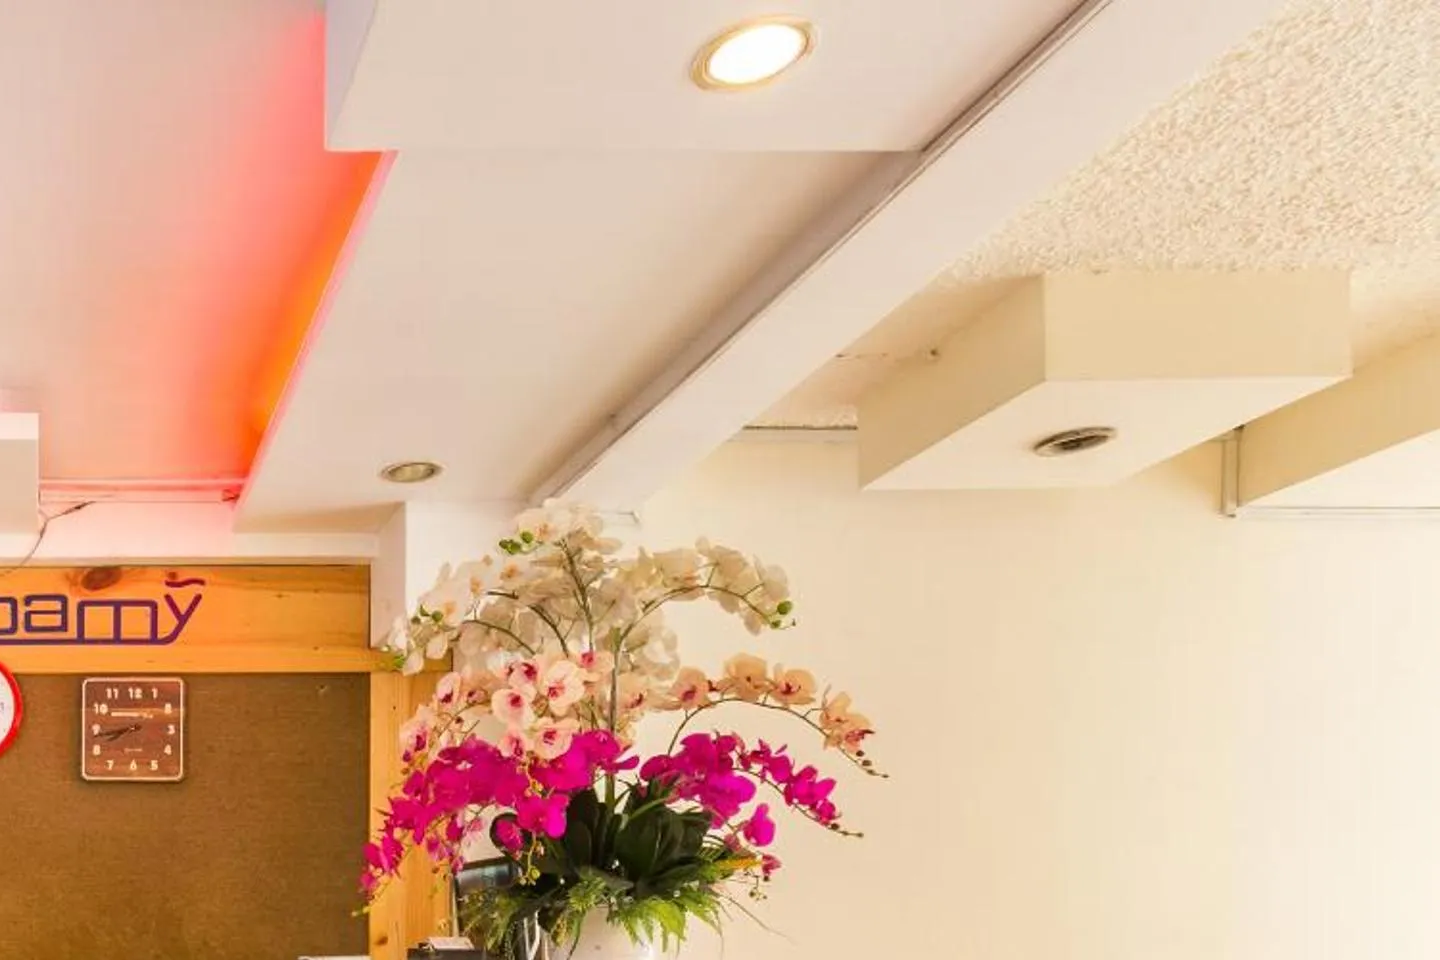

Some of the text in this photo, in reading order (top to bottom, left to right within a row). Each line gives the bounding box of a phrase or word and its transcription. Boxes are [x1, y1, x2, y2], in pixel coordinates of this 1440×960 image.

[106, 687, 119, 699] 11
[94, 702, 108, 714] 10
[106, 760, 114, 771] 7
[130, 759, 137, 770] 6
[150, 760, 158, 771] 5
